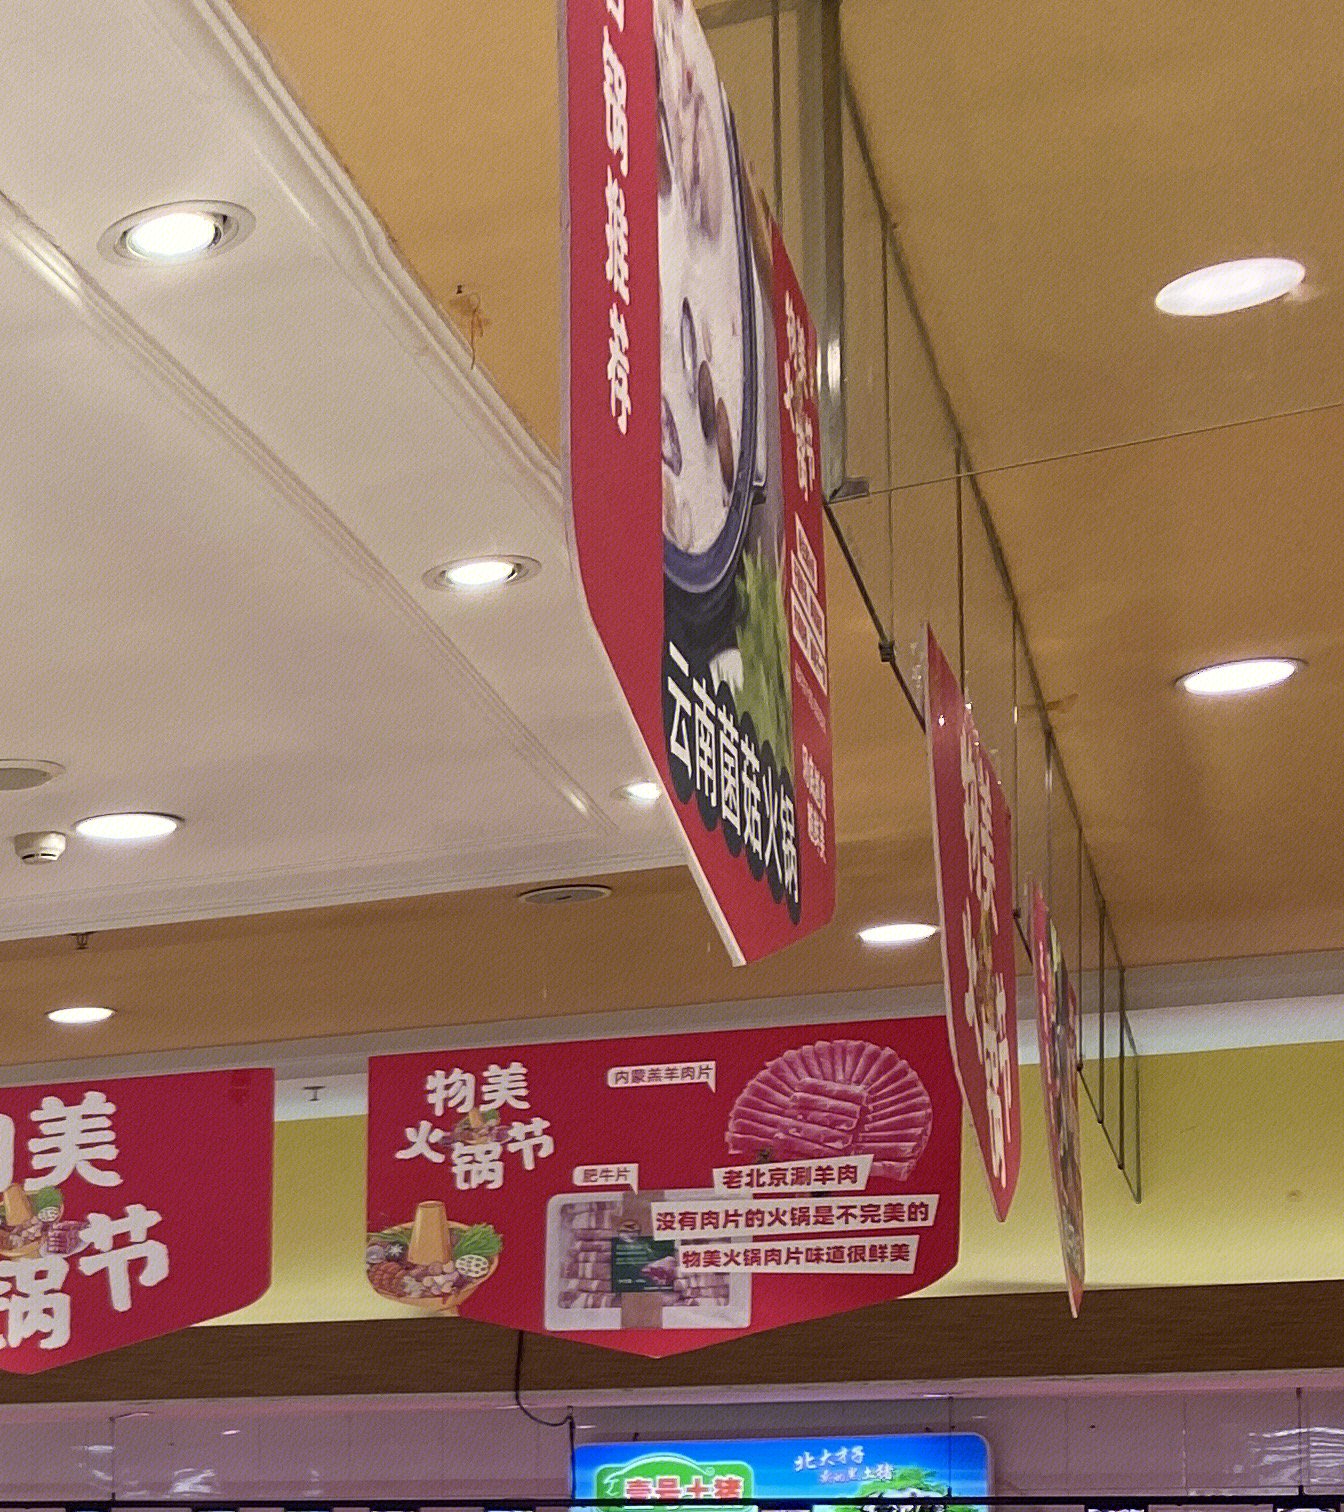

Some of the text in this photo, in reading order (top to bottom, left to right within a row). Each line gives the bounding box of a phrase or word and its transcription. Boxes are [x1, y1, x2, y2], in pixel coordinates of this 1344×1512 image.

[602, 0, 631, 435] 锅推荐
[668, 641, 799, 902] 云南菌菇火锅
[426, 1062, 531, 1117] 物美
[395, 1118, 554, 1191] 火锅节
[582, 1166, 631, 1184] 肥牛片
[722, 1161, 859, 1189] 老北京涮羊肉
[655, 1201, 930, 1233] 没有肉片的火锅是不完美的
[681, 1243, 911, 1268] 物美火锅肉片味道很鲜美
